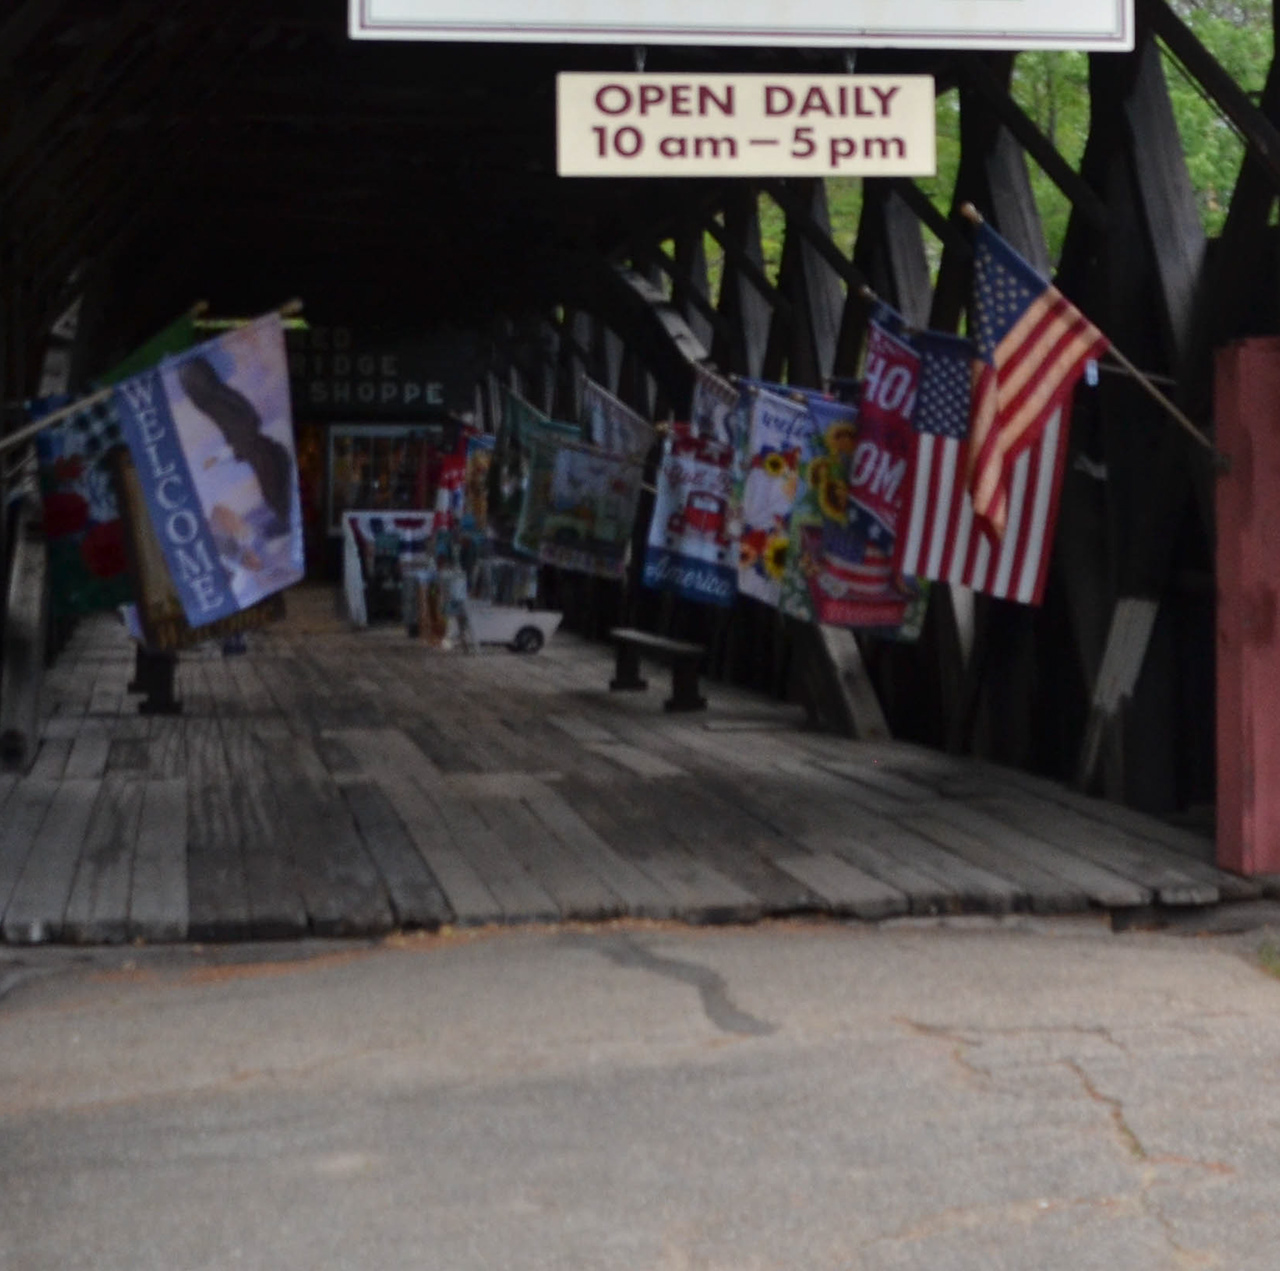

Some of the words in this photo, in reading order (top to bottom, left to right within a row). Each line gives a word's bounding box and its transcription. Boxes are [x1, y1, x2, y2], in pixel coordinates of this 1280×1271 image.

[593, 84, 736, 117] OPEN
[763, 85, 900, 117] DAILY
[591, 125, 644, 158] 10
[830, 134, 907, 168] pm
[310, 381, 445, 405] SHOPPE
[120, 372, 223, 612] WELCOME
